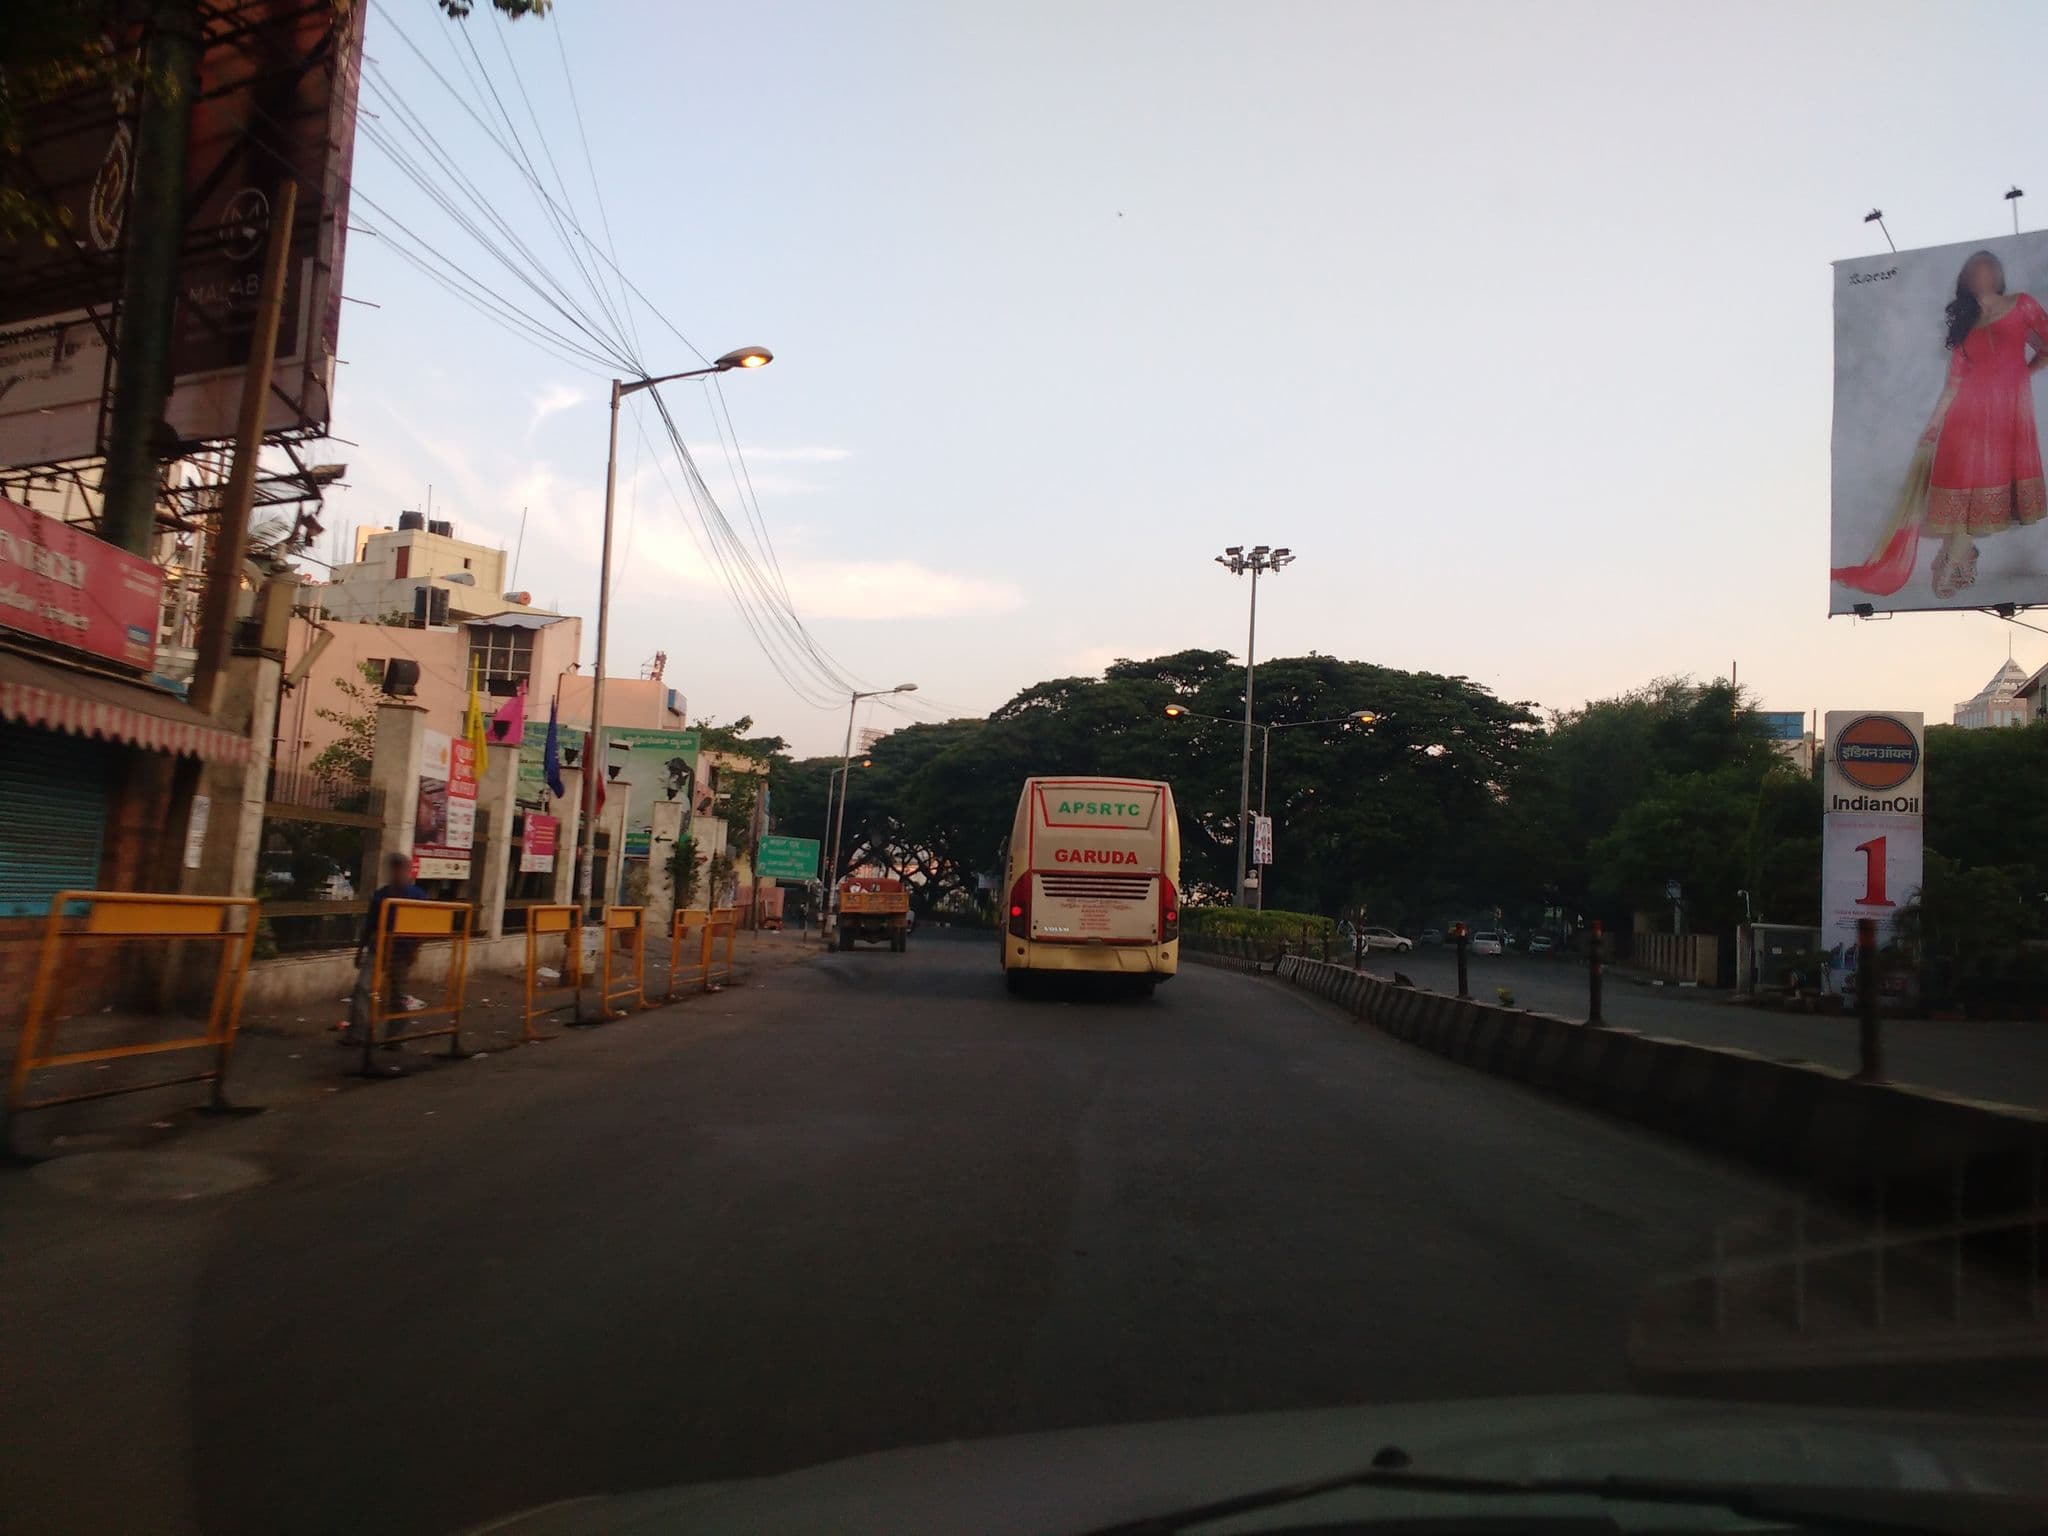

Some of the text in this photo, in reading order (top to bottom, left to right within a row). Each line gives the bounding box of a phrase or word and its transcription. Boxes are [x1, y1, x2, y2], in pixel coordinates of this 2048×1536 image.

[1842, 744, 1912, 760] इंडियनऑयल
[1059, 800, 1141, 817] APSRTC
[1832, 794, 1919, 813] IndianOil
[1055, 848, 1138, 864] GARUDA
[1854, 835, 1896, 907] 1
